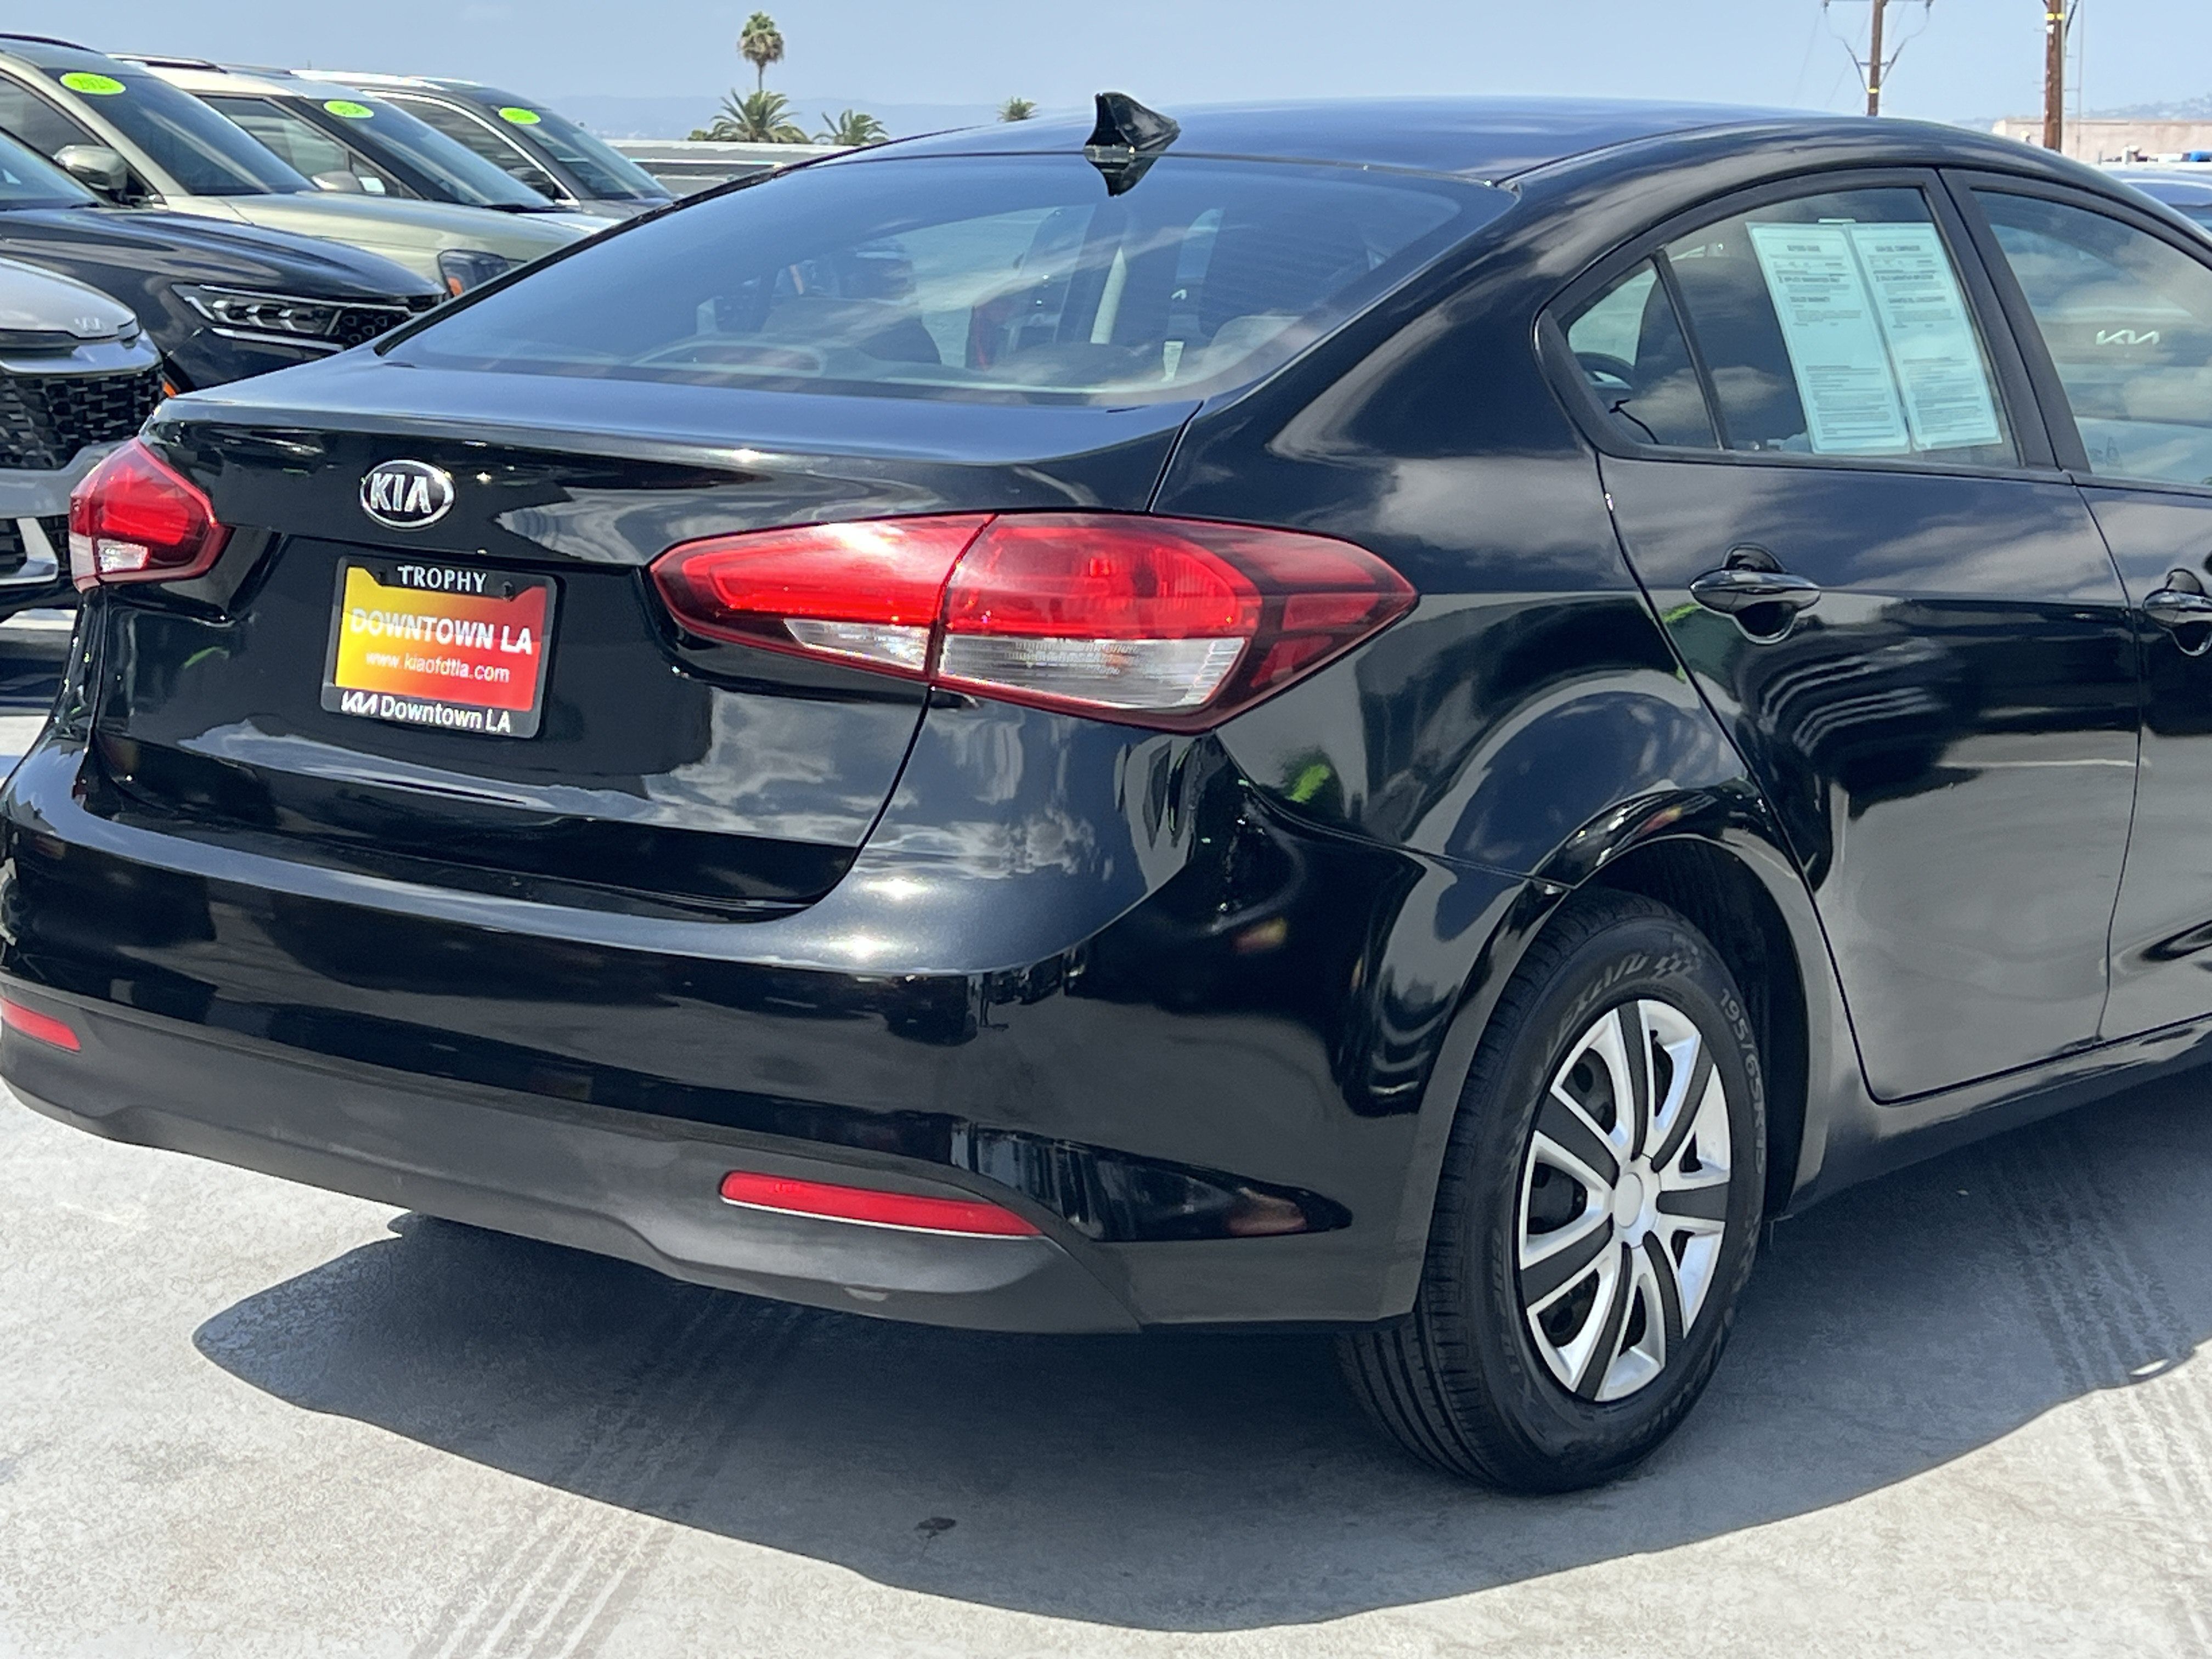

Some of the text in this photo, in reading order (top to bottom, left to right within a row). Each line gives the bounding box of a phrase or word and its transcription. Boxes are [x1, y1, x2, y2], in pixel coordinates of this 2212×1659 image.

[370, 472, 432, 514] KIA
[397, 565, 488, 593] TROPHY
[350, 608, 533, 655] DOWNTOWN LA
[365, 651, 510, 683] www.kiaofdtla.com
[341, 690, 511, 733] KIA Downtown LA
